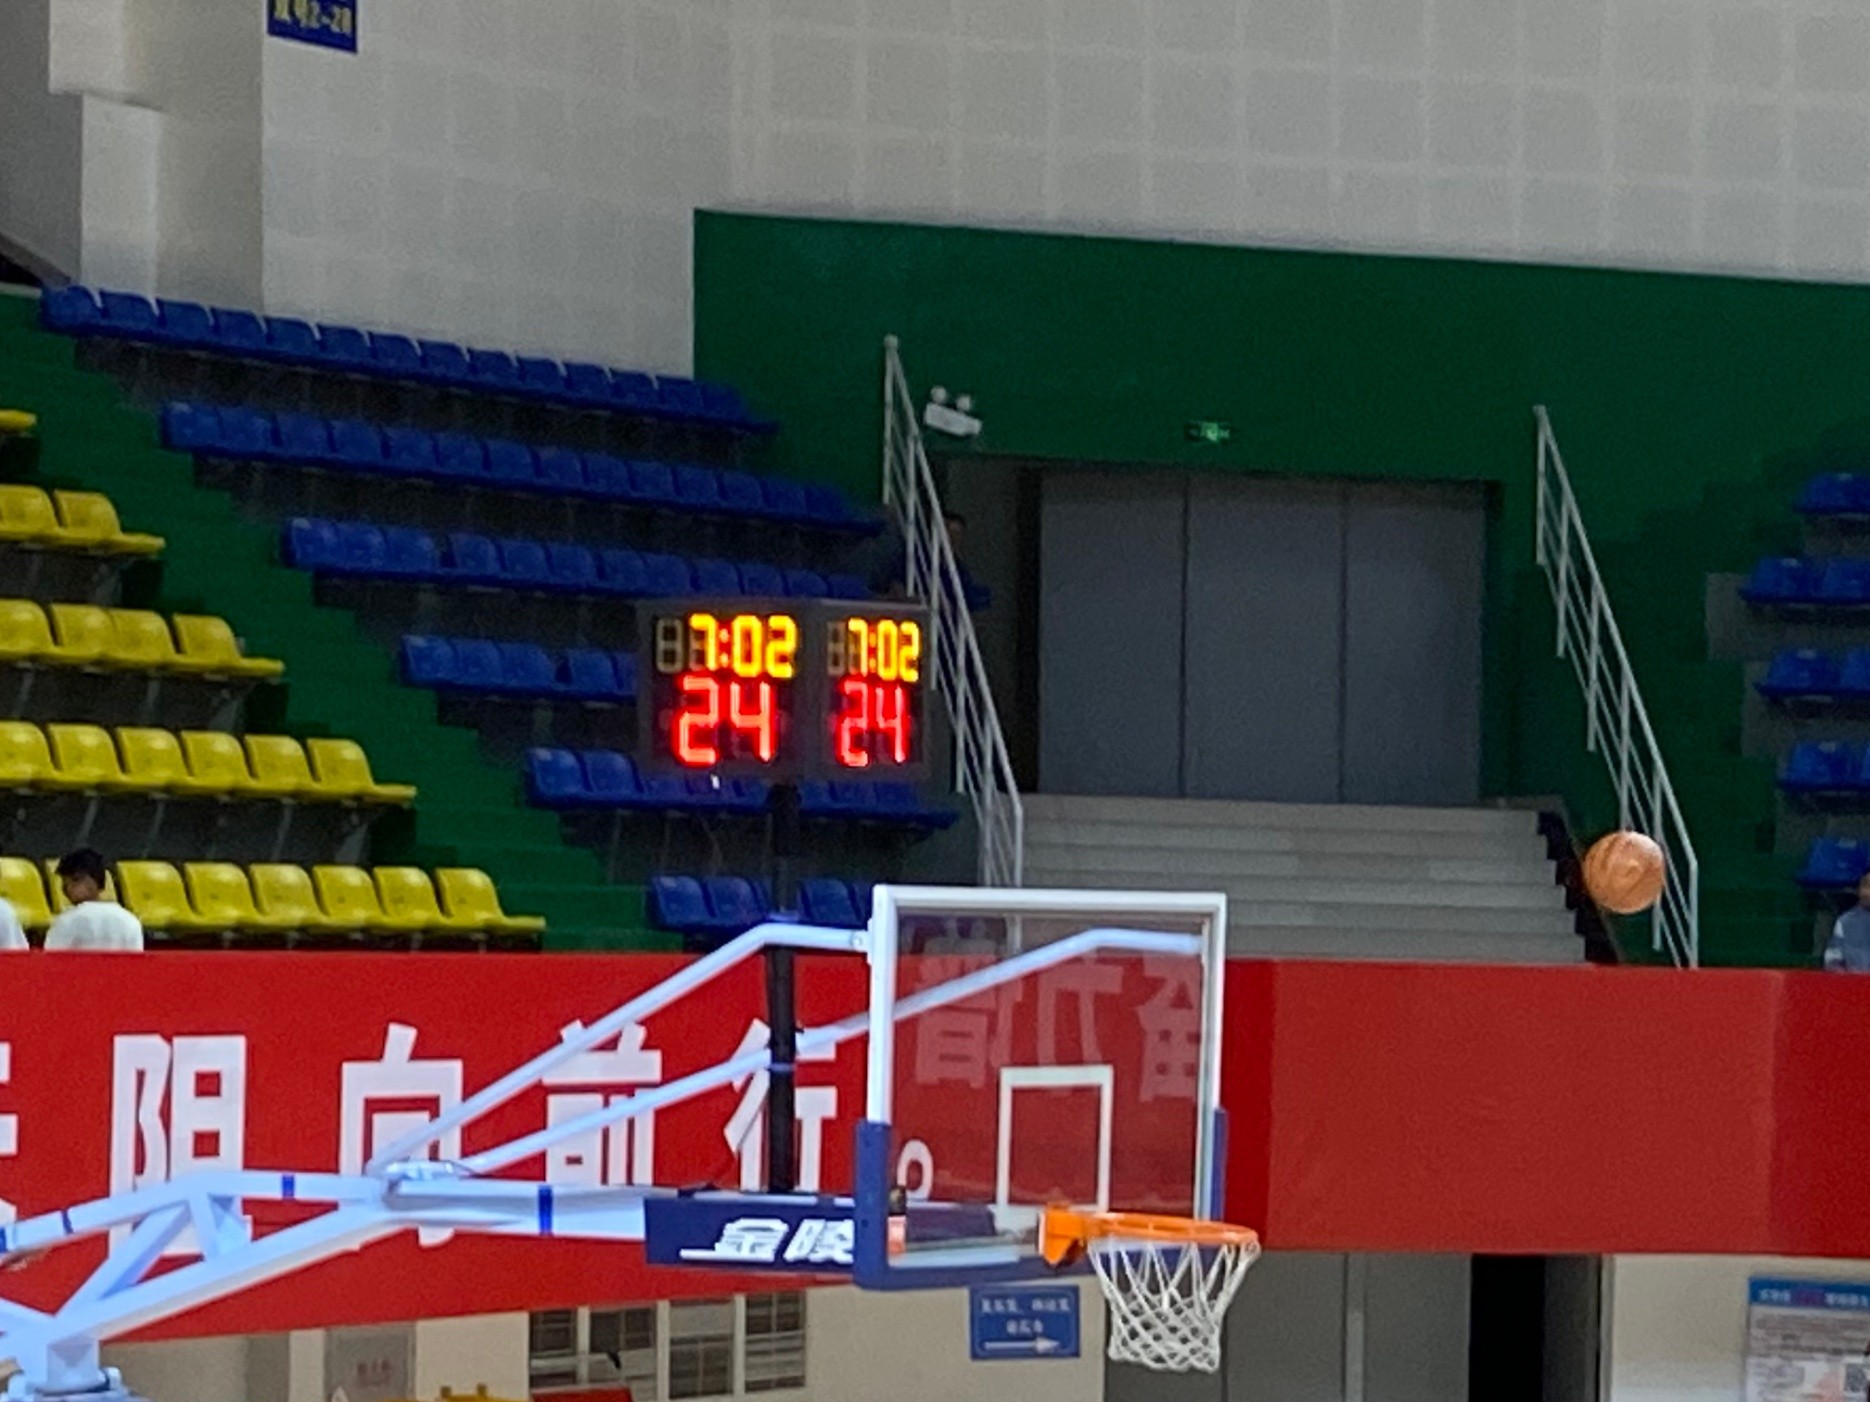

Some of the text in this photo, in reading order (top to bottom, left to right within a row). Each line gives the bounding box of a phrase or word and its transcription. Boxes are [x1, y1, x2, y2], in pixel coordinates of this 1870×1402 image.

[690, 613, 797, 678] 7:02
[848, 617, 920, 682] 7:02
[678, 675, 771, 764] 24
[840, 679, 907, 767] 24
